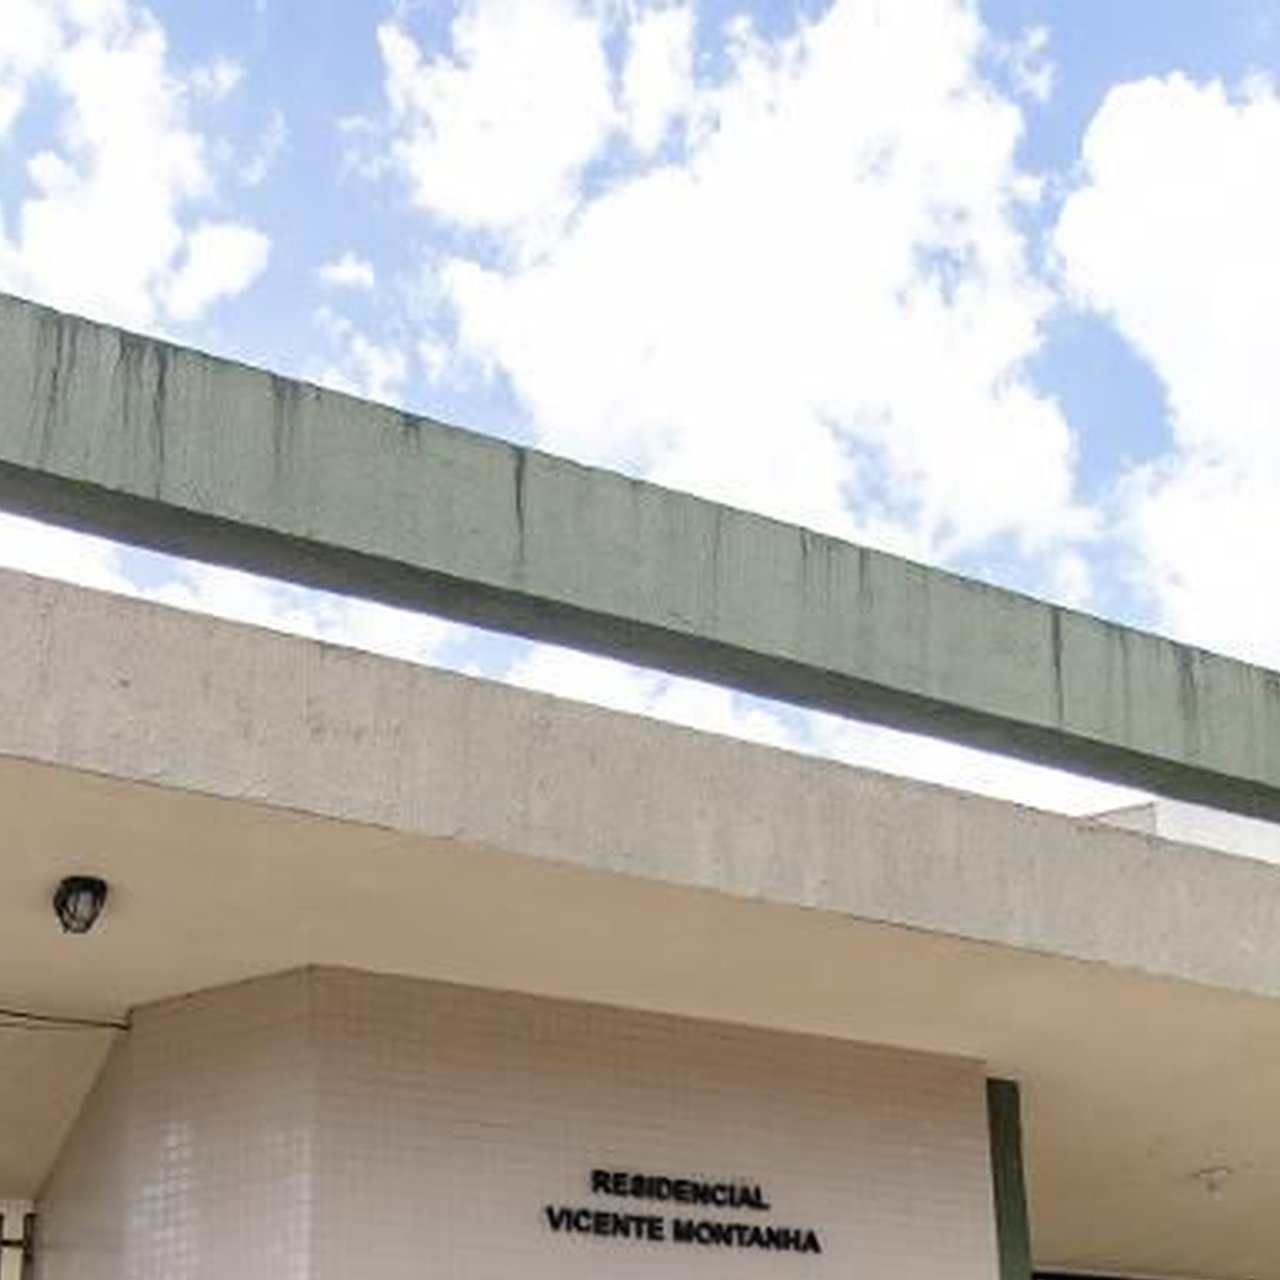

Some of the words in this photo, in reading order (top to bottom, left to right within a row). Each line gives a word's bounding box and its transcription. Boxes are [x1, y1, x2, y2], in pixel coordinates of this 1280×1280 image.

[591, 1168, 772, 1211] RESIDENCIAL
[545, 1205, 666, 1242] VICENTE
[672, 1217, 823, 1255] MONTANHA
